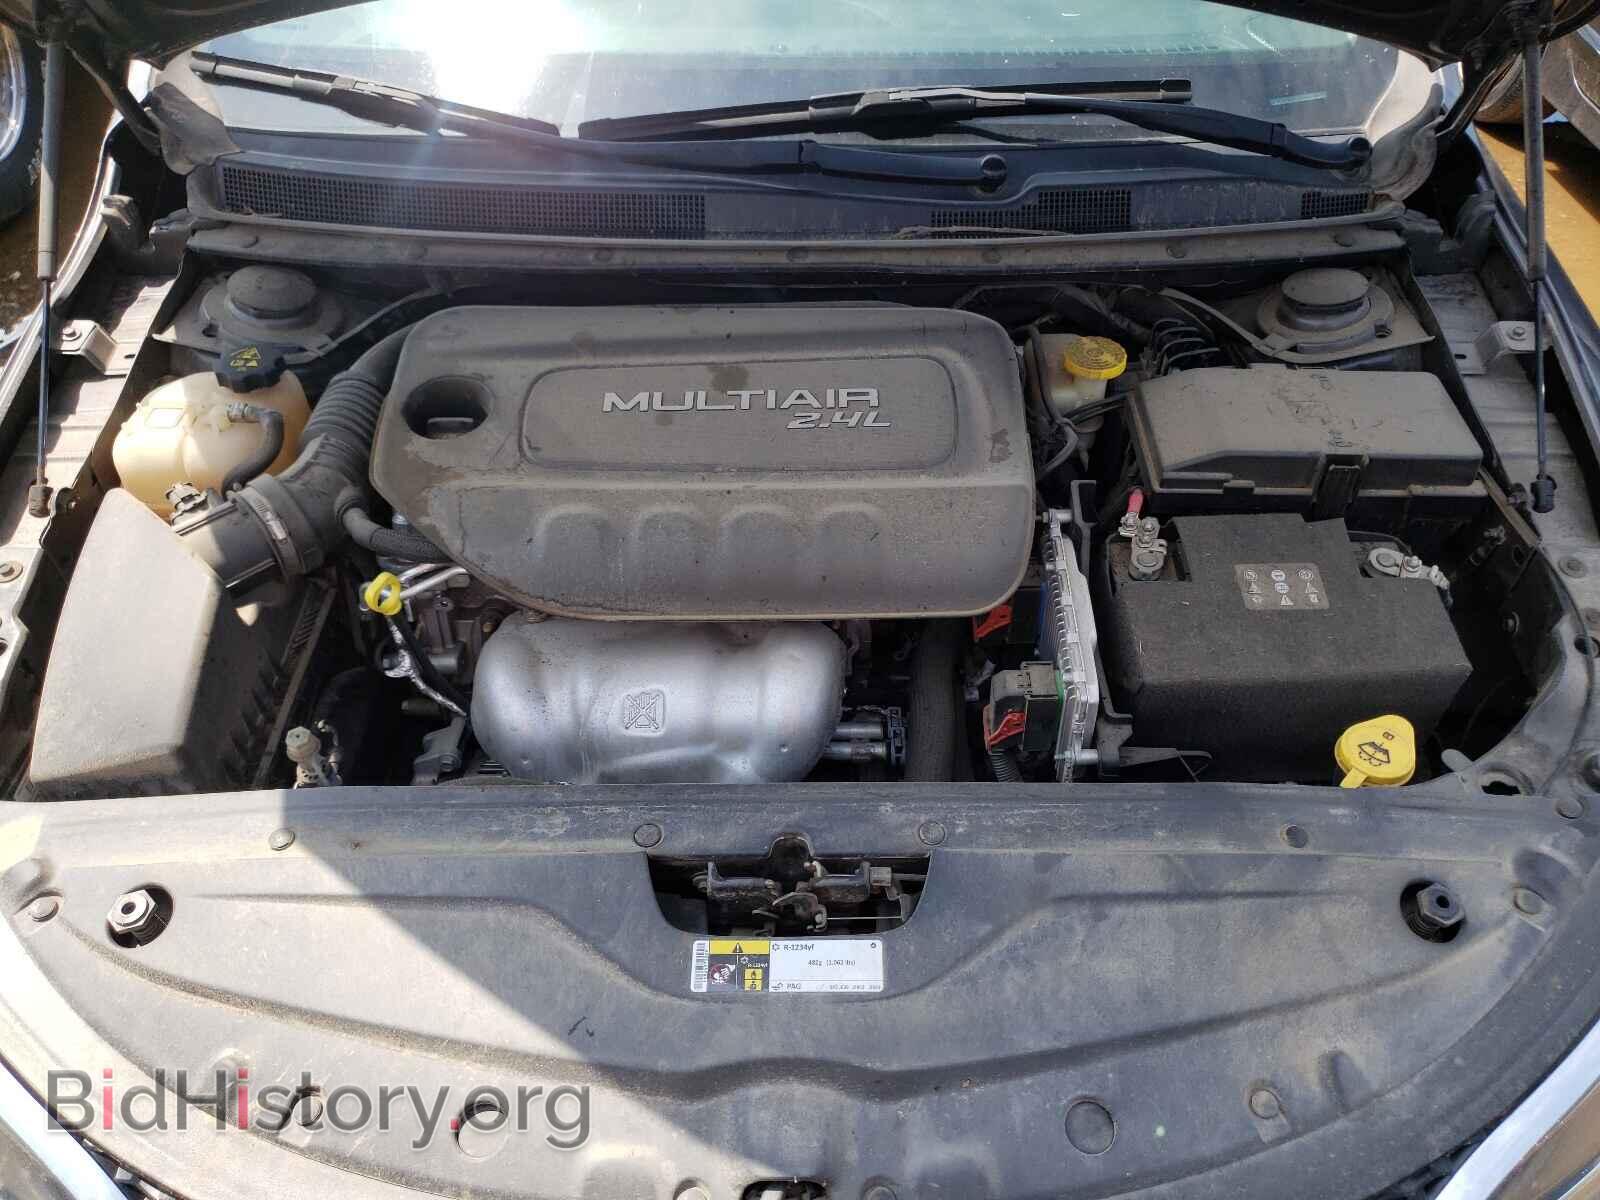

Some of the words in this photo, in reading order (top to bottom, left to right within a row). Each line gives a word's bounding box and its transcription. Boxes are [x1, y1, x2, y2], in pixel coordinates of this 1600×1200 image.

[602, 388, 880, 412] MULTIAIR
[786, 411, 891, 429] 2.4L
[783, 944, 815, 952] R-1234yf
